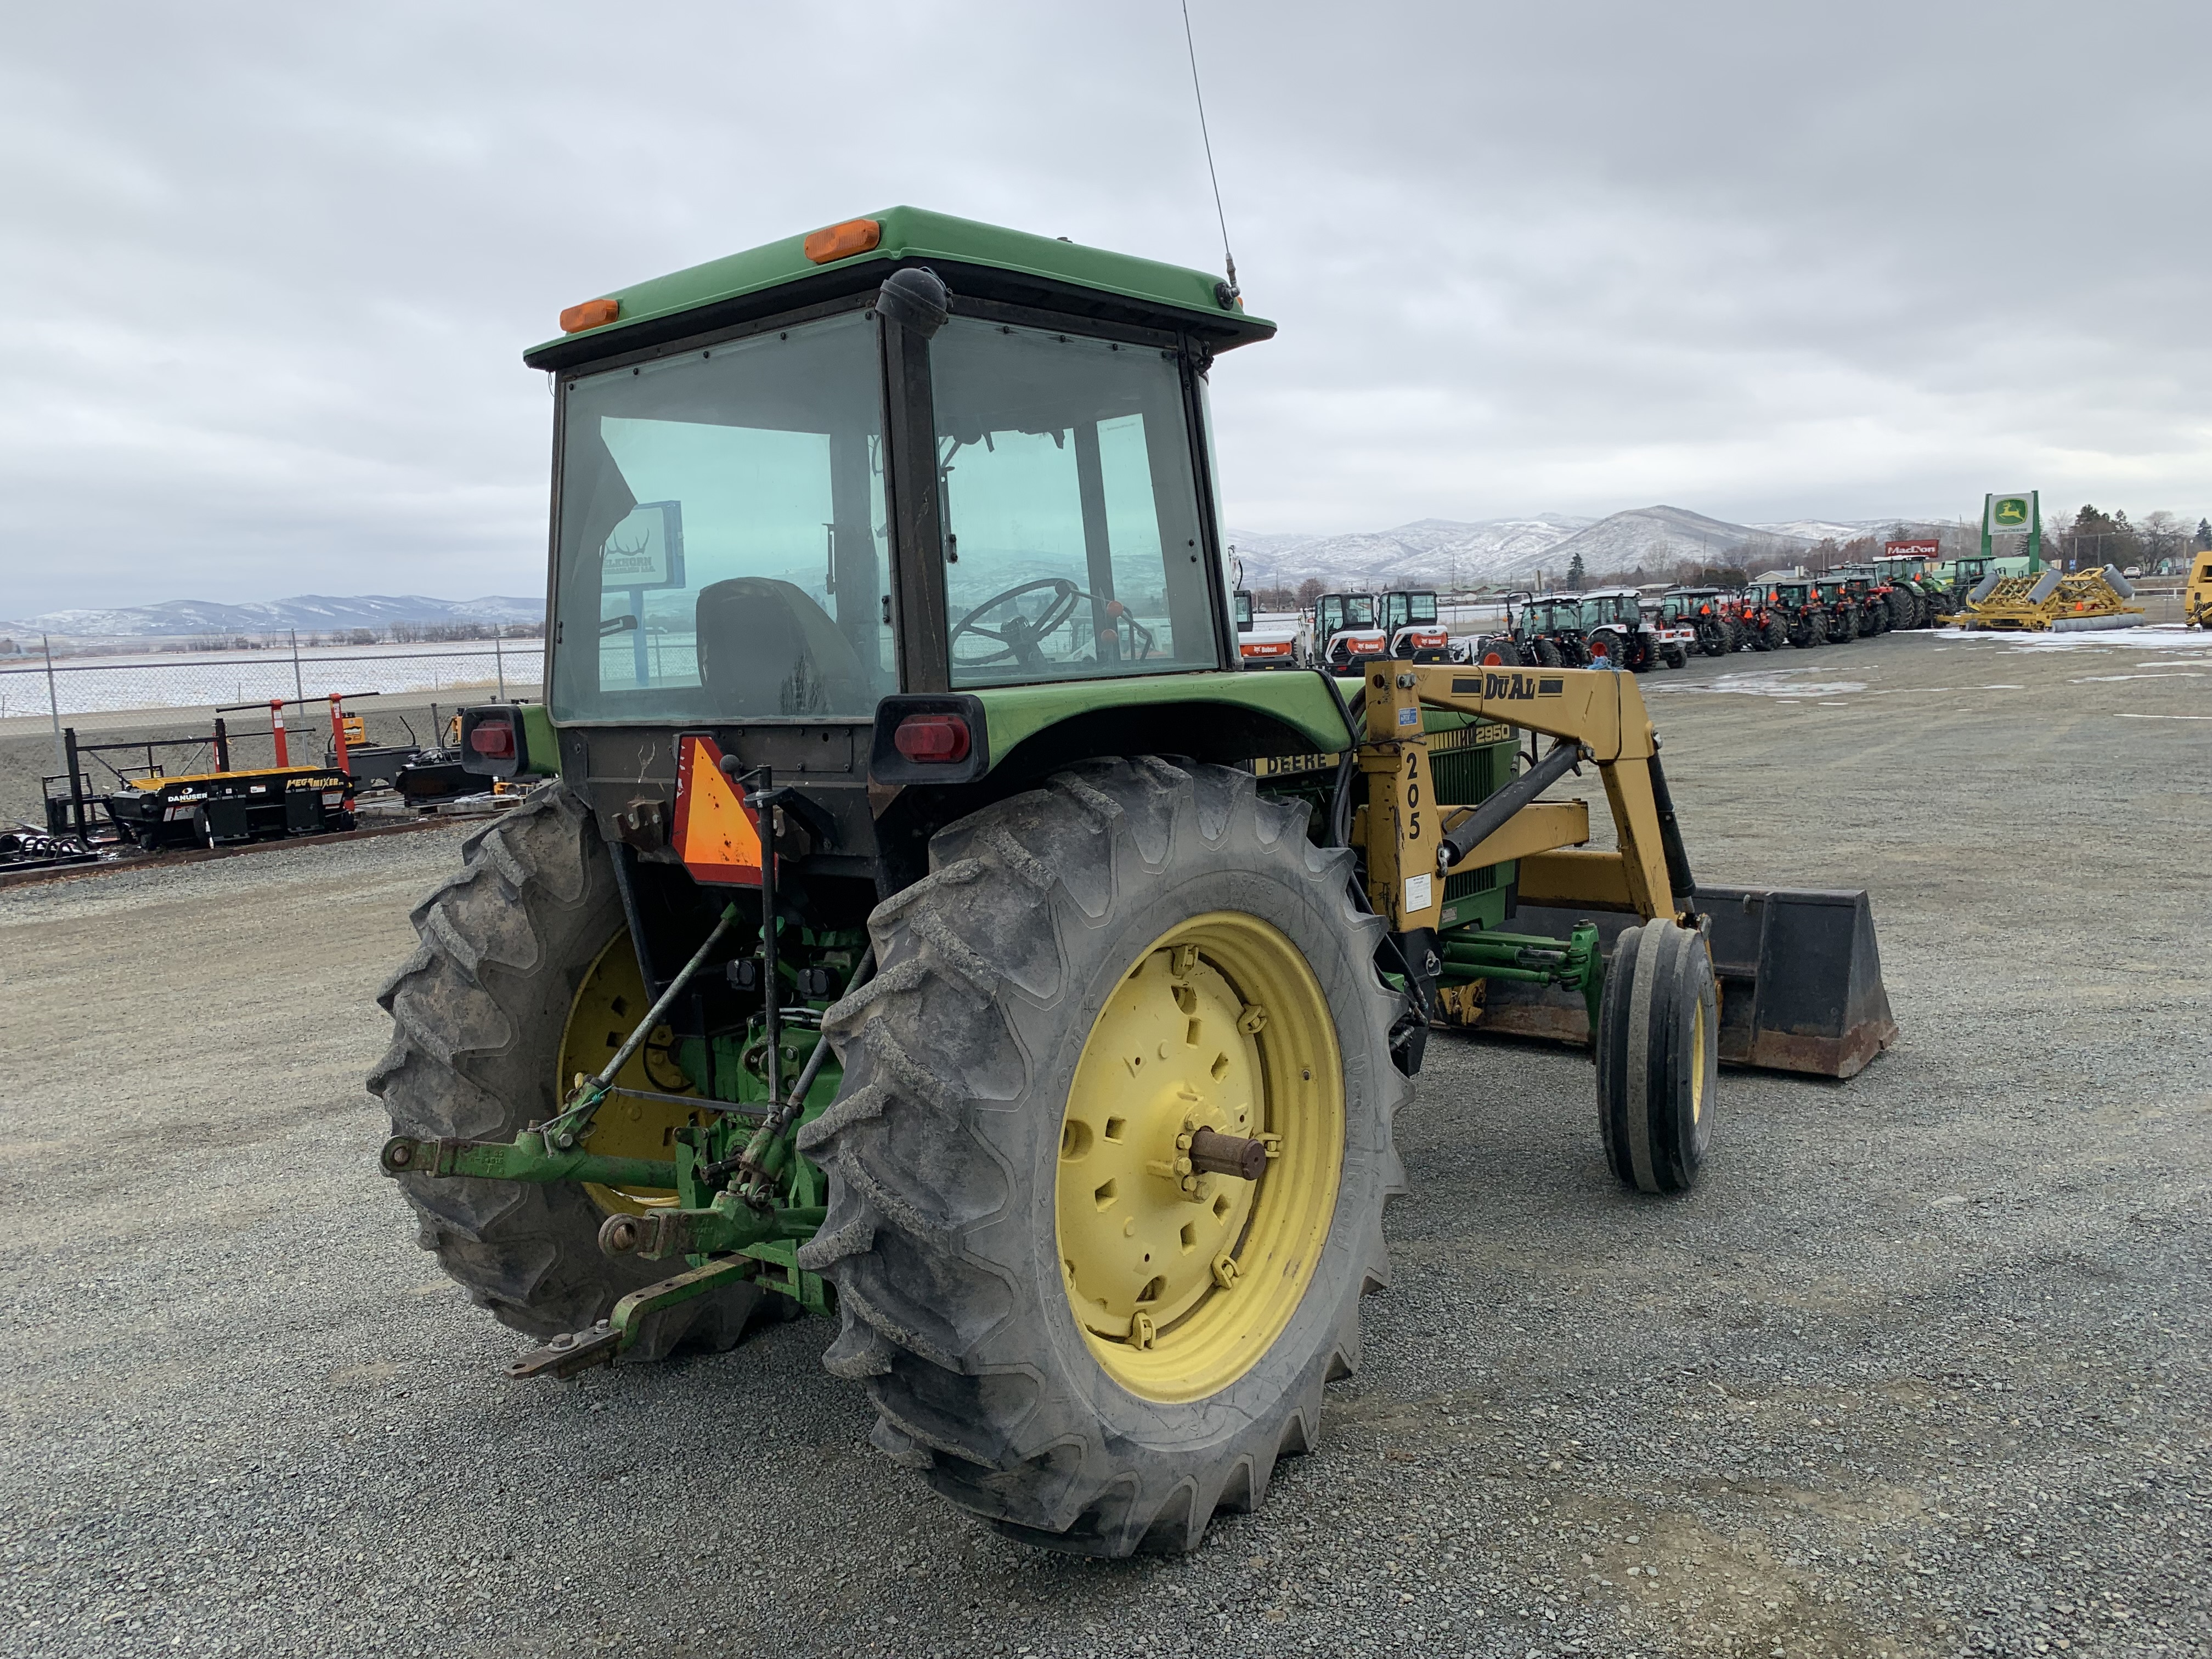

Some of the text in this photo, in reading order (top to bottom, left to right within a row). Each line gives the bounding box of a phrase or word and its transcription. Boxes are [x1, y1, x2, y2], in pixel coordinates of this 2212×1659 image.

[1888, 546, 1936, 554] MacDon
[1476, 724, 1510, 744] 2950
[1267, 753, 1327, 774] DEERE
[168, 793, 207, 802] DANUSER
